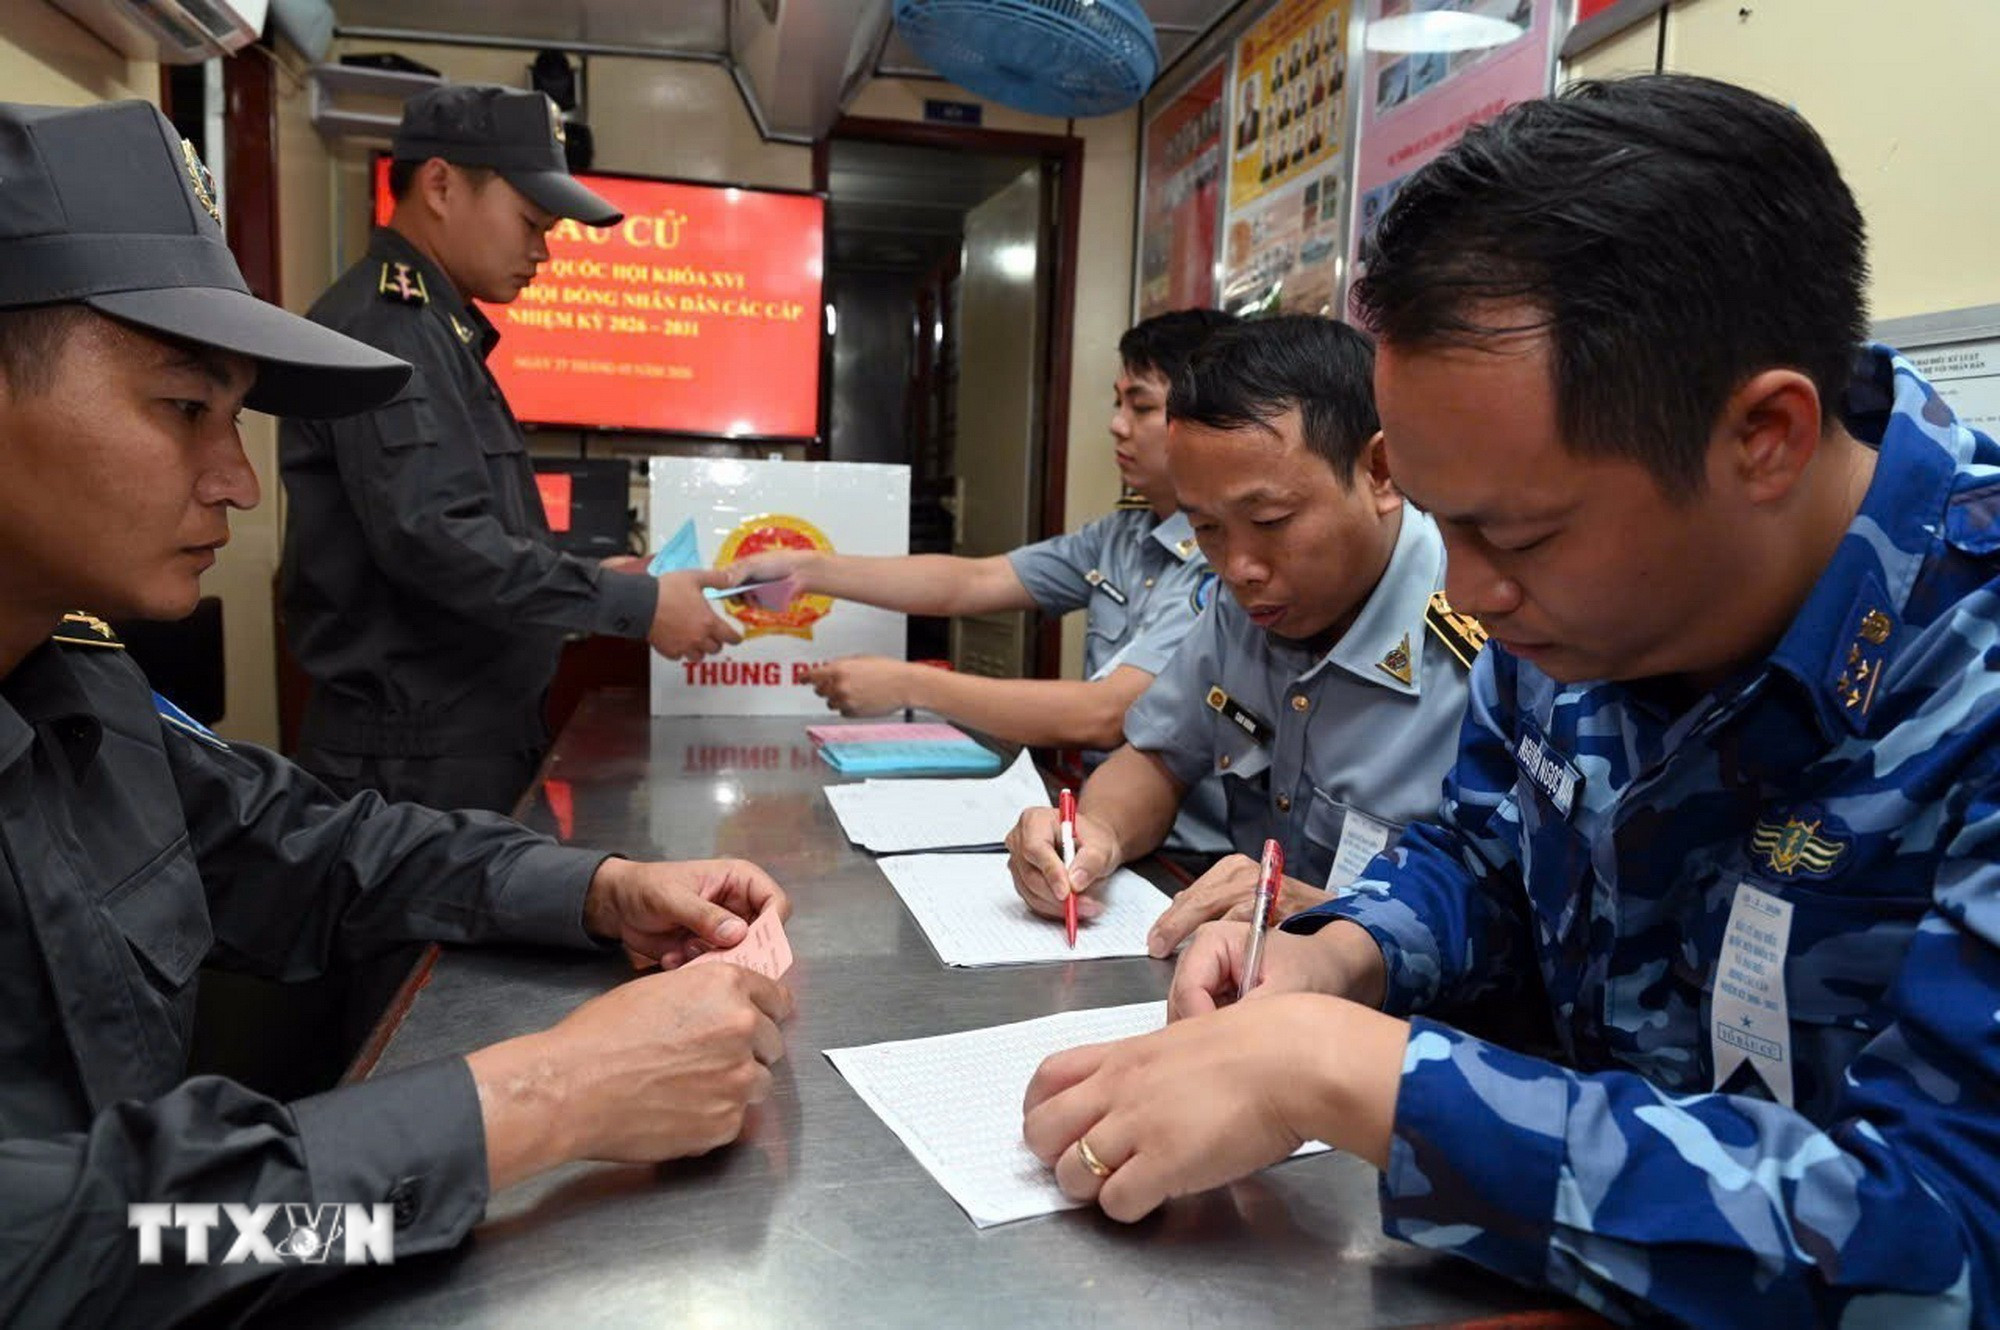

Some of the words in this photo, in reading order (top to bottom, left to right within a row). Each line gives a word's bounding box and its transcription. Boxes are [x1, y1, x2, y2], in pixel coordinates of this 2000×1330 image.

[623, 209, 688, 249] CỬ
[712, 271, 746, 290] XVI
[622, 289, 676, 310] NHÂN
[679, 292, 721, 314] DÂN
